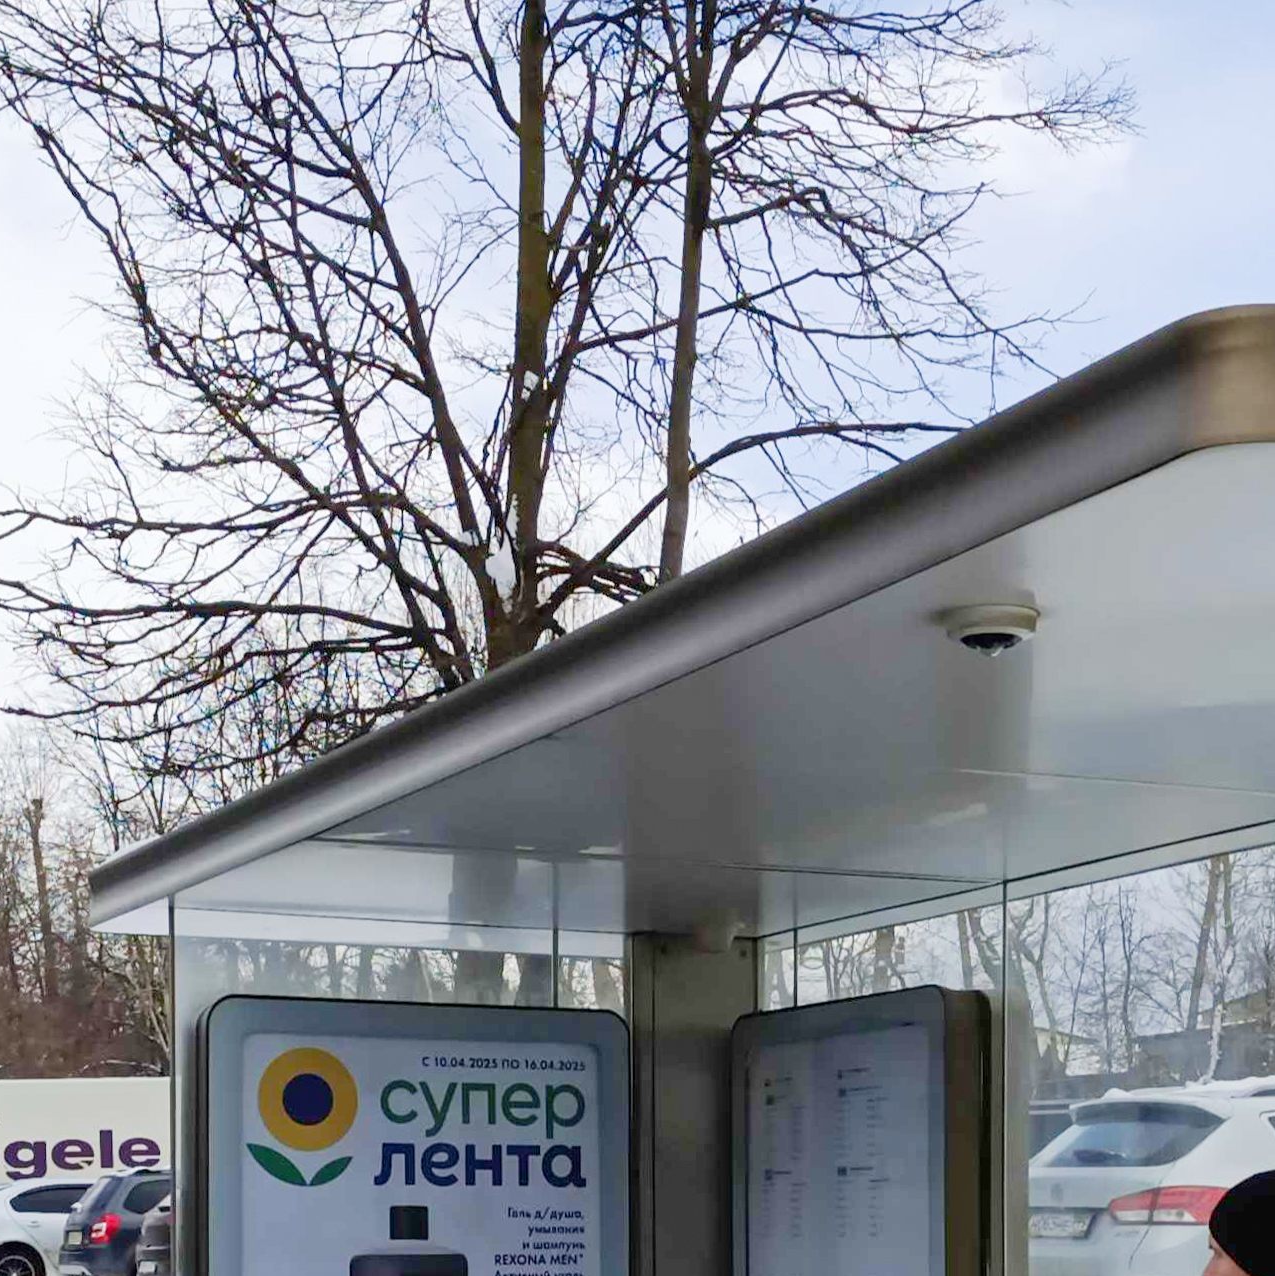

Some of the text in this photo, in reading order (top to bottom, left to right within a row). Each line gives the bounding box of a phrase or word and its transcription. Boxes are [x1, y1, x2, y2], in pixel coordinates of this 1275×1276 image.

[434, 1057, 498, 1069] 10.04.2025
[501, 1059, 520, 1070] ПО
[524, 1060, 586, 1072] 16.04.2025
[380, 1079, 586, 1139] супер
[374, 1142, 586, 1188] лента
[494, 1254, 546, 1266] REXONA
